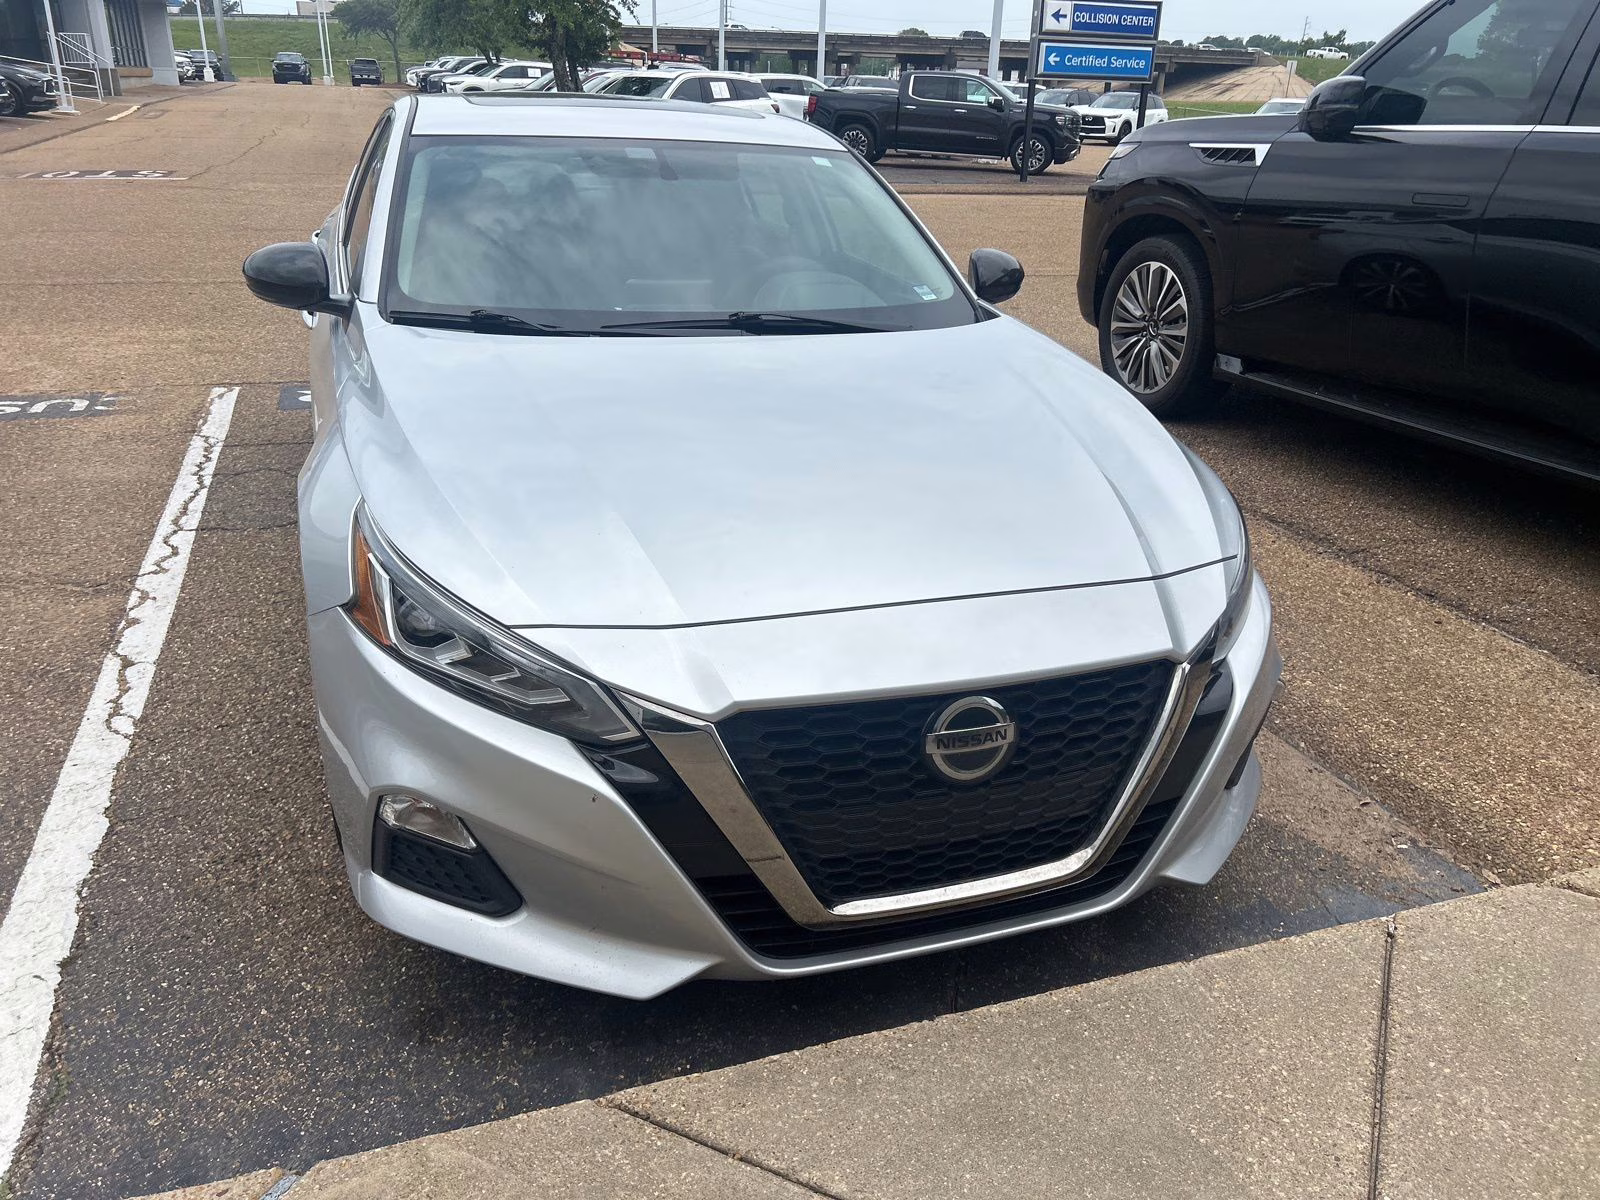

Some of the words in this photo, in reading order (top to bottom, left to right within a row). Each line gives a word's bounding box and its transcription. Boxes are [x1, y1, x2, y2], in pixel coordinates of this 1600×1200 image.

[1074, 12, 1118, 25] COLLISION
[1121, 15, 1154, 26] CENTER
[1064, 54, 1107, 67] Certified
[1110, 56, 1146, 68] Service
[936, 728, 1008, 750] NISSAN
